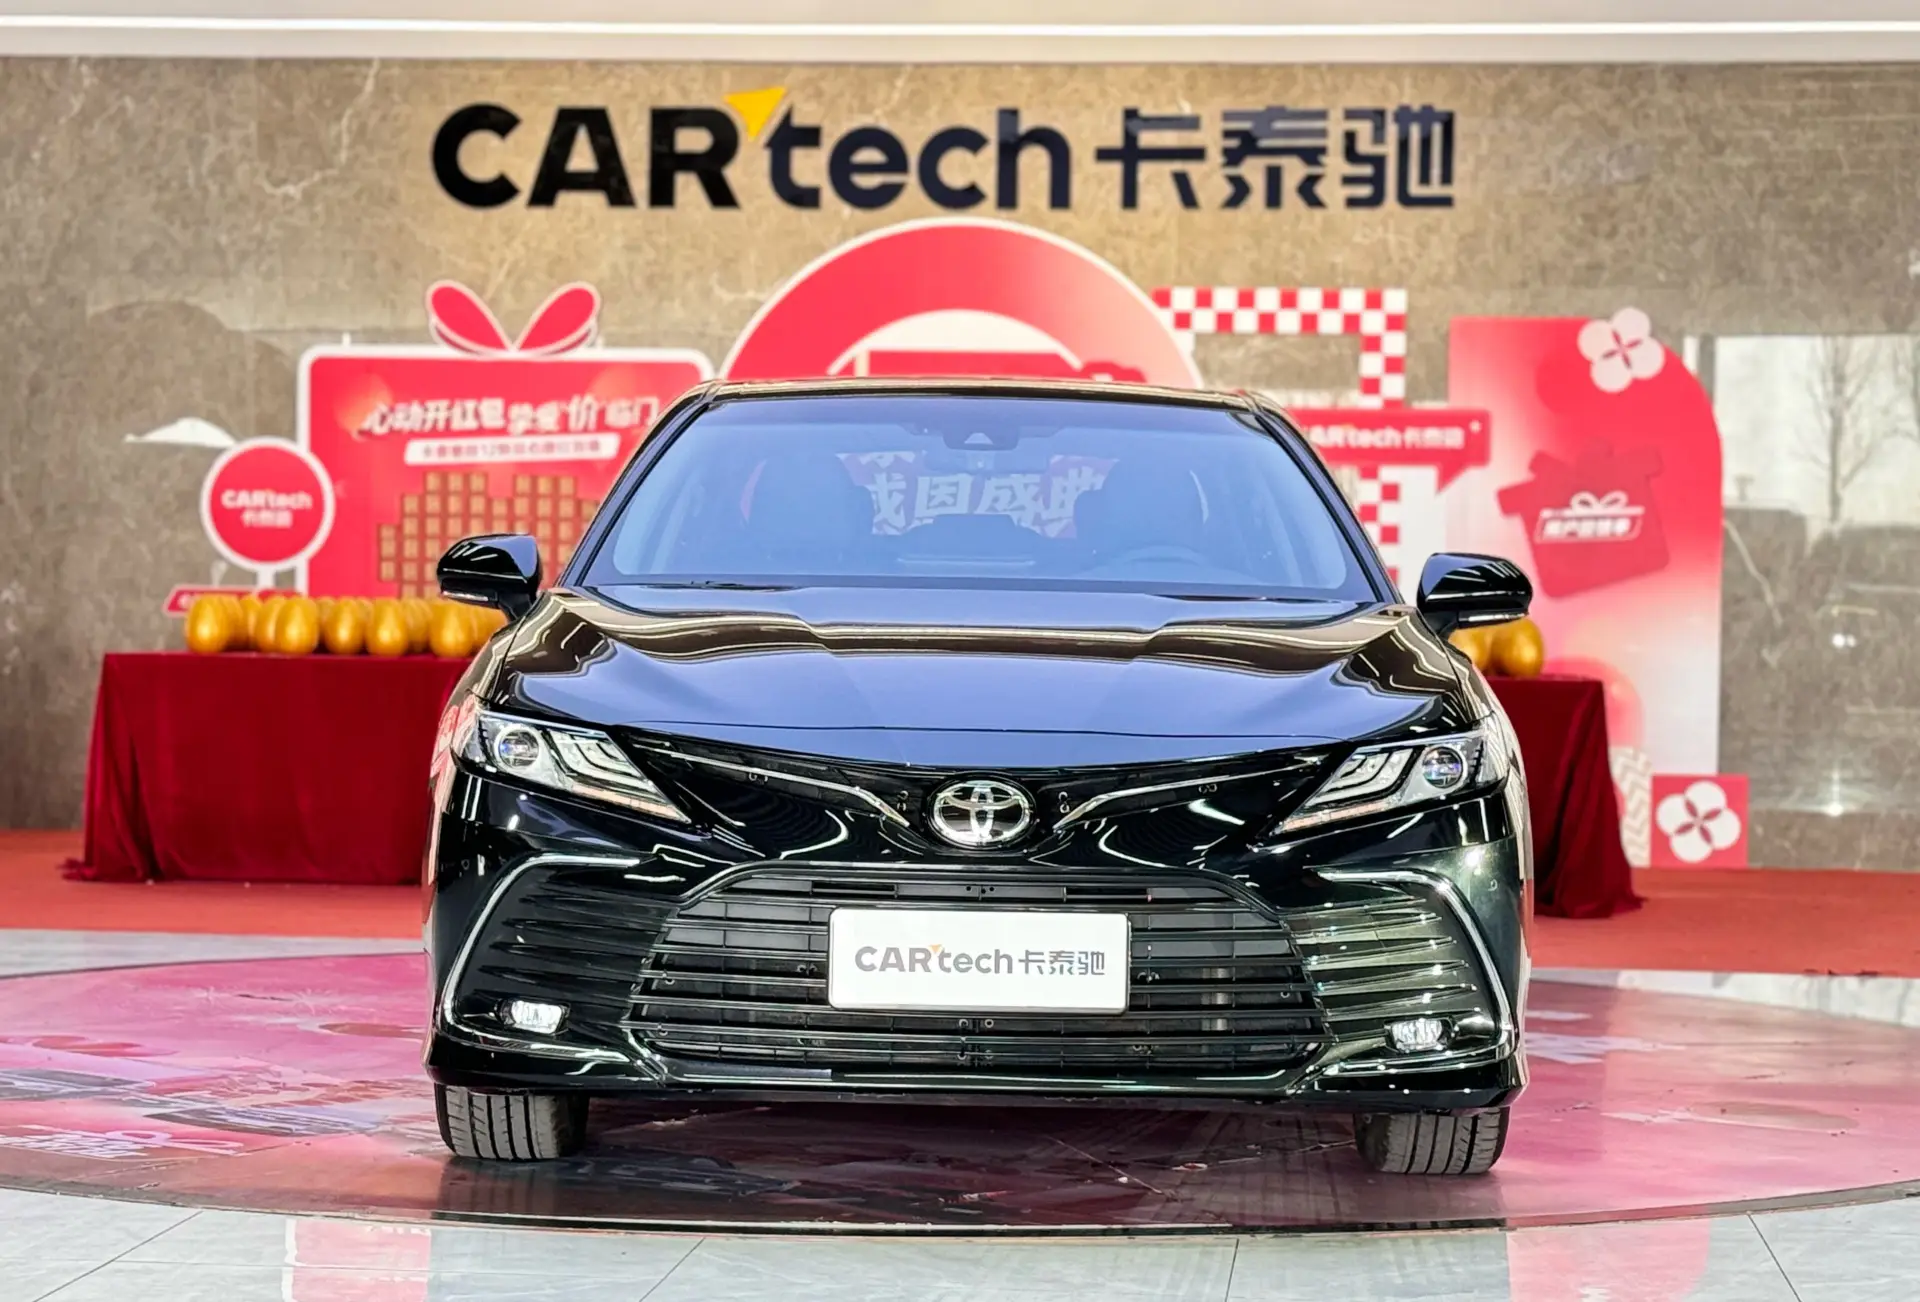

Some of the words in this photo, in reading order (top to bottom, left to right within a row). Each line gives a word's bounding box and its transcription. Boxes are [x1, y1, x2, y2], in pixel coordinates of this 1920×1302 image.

[432, 100, 1071, 209] CARtech
[1097, 107, 1455, 209] 卡泰驰
[1302, 425, 1402, 449] ARtech
[854, 945, 1013, 974] CARtech
[1018, 950, 1105, 976] 卡泰驰
